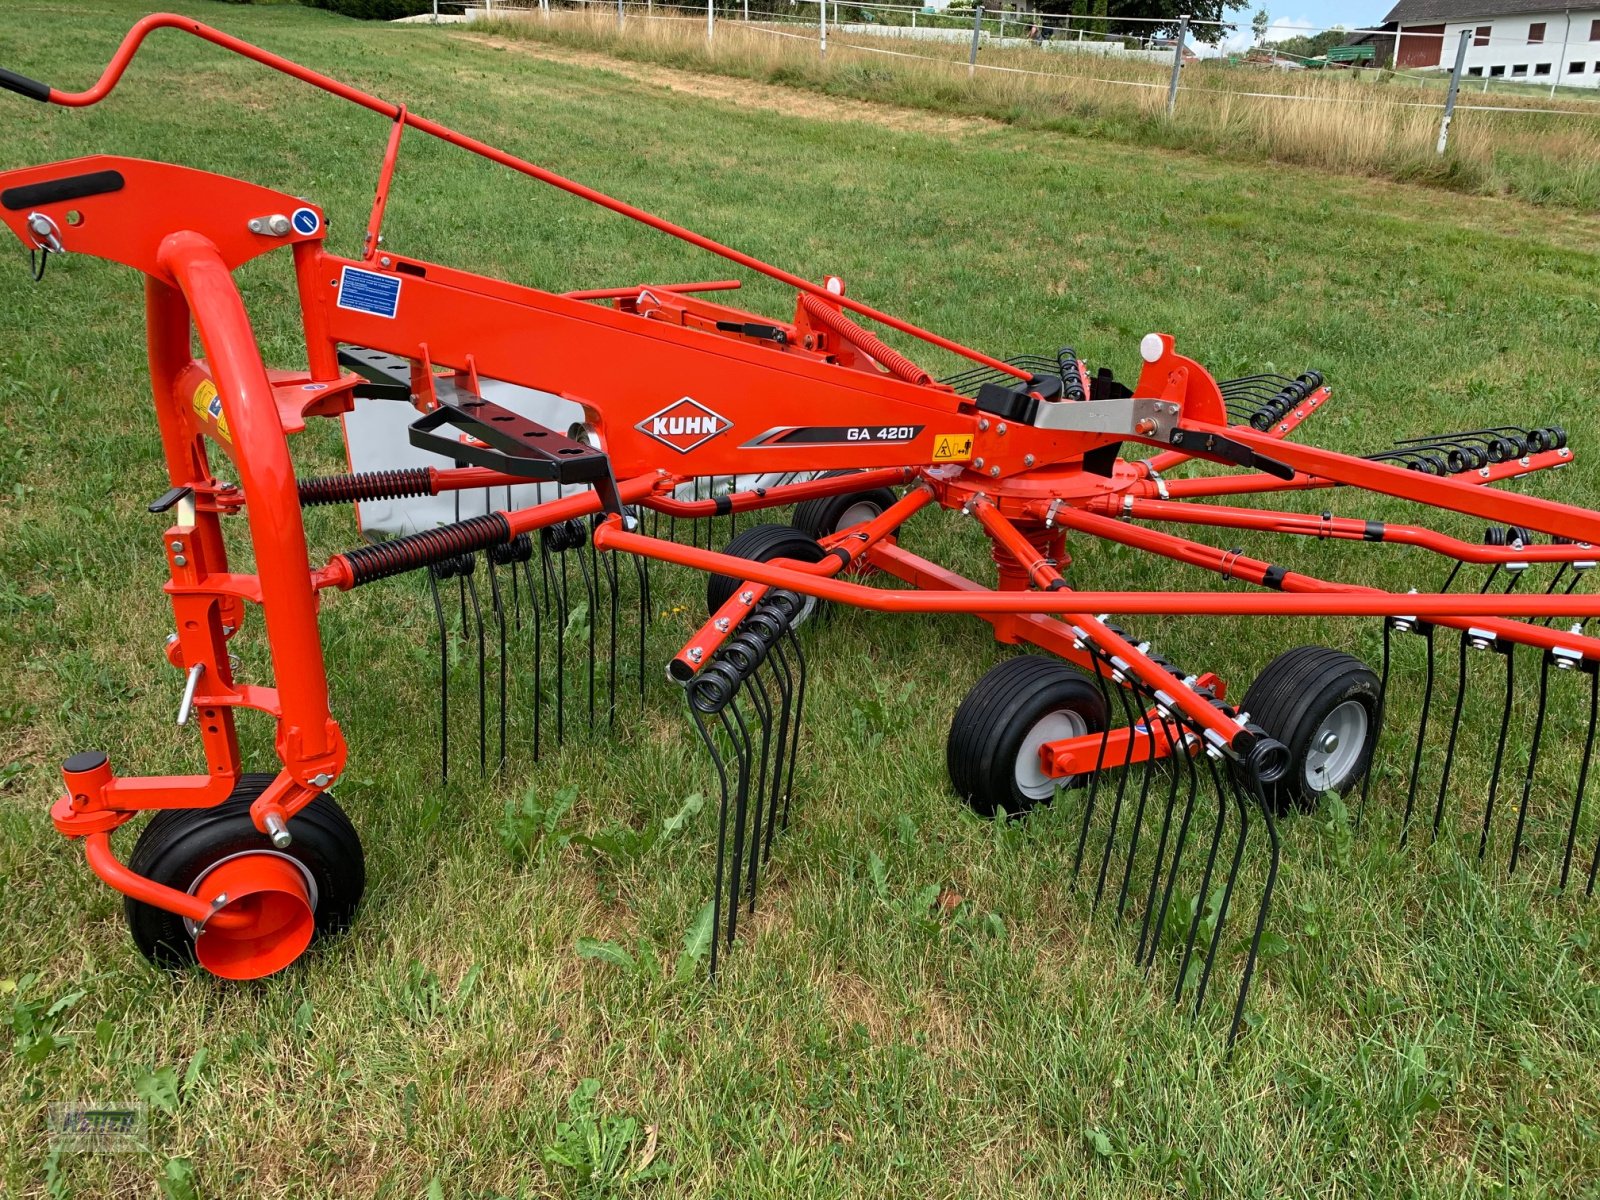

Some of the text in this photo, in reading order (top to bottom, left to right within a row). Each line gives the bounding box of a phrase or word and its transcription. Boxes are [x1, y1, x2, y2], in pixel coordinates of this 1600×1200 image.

[653, 416, 717, 435] KUHN
[847, 426, 914, 441] GA 4201
